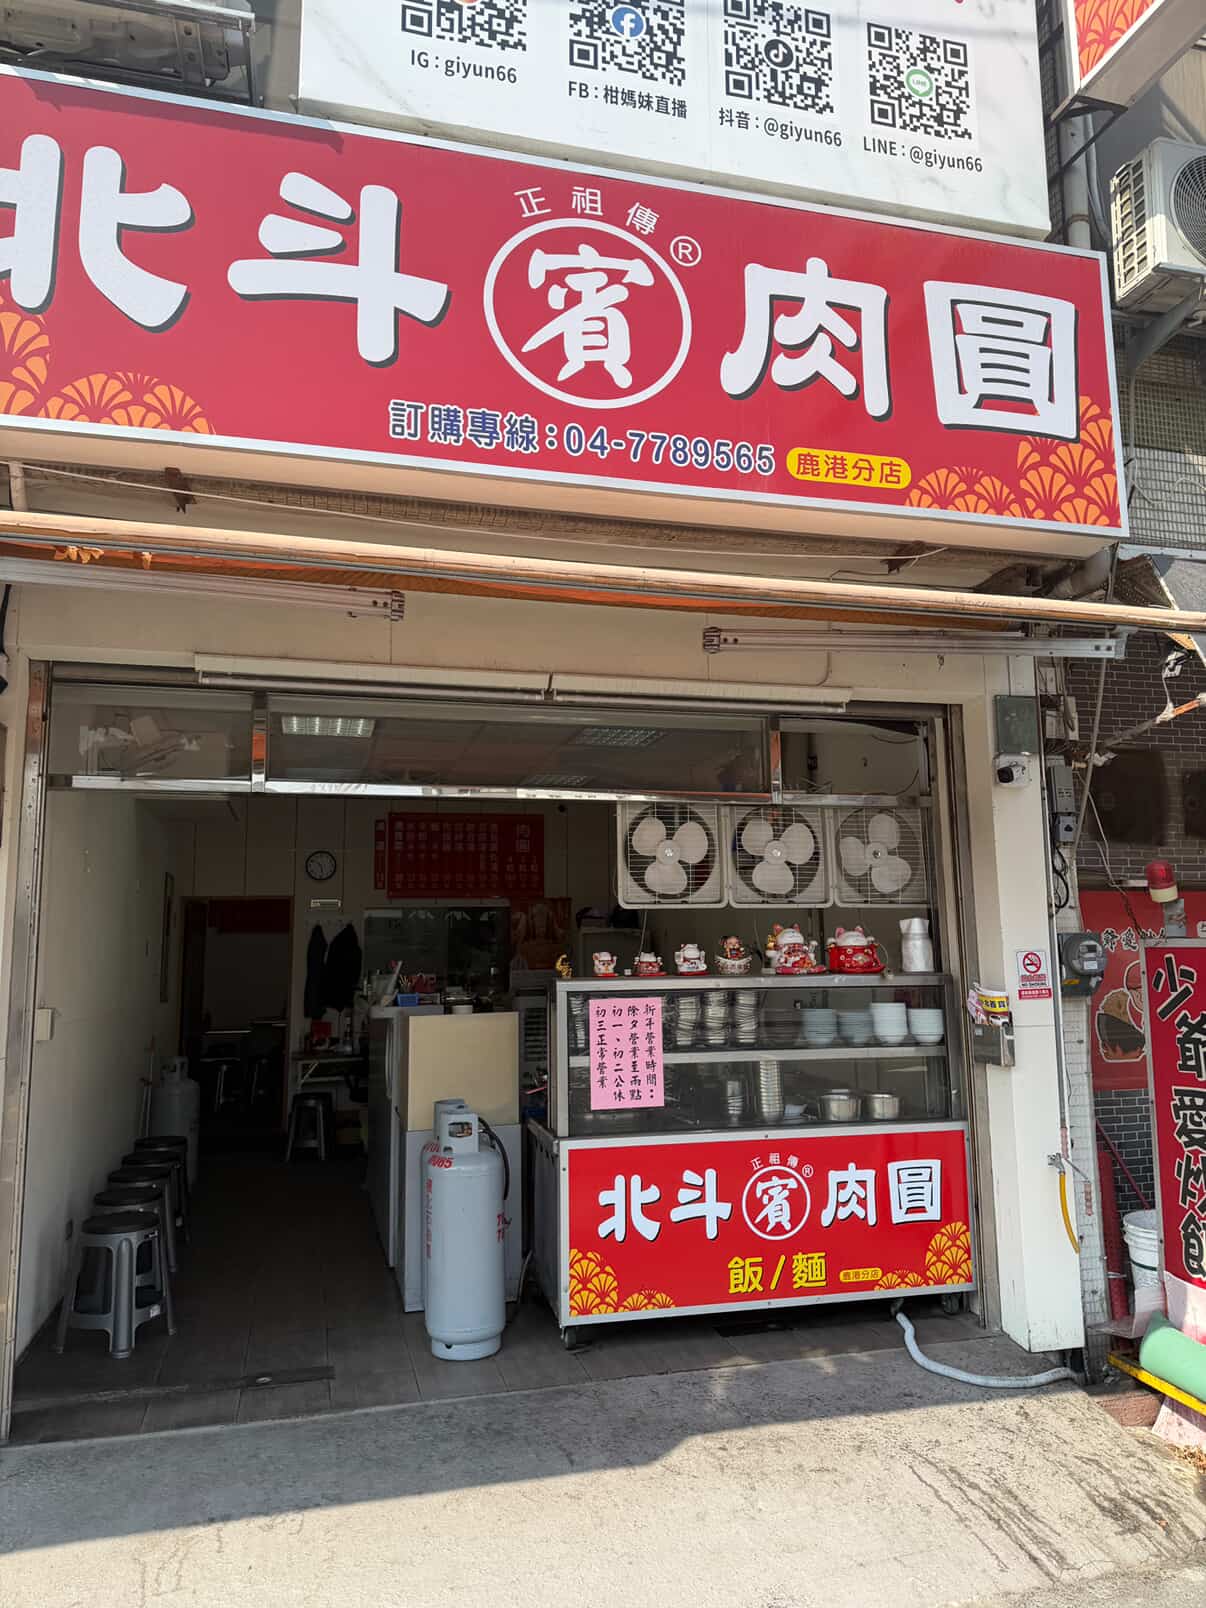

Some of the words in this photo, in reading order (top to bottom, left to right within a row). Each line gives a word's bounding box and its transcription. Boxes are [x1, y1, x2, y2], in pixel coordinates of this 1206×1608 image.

[513, 186, 660, 235] 正祖傳
[794, 450, 904, 486] 鹿港分店
[596, 1006, 608, 1089] 初三正常營業
